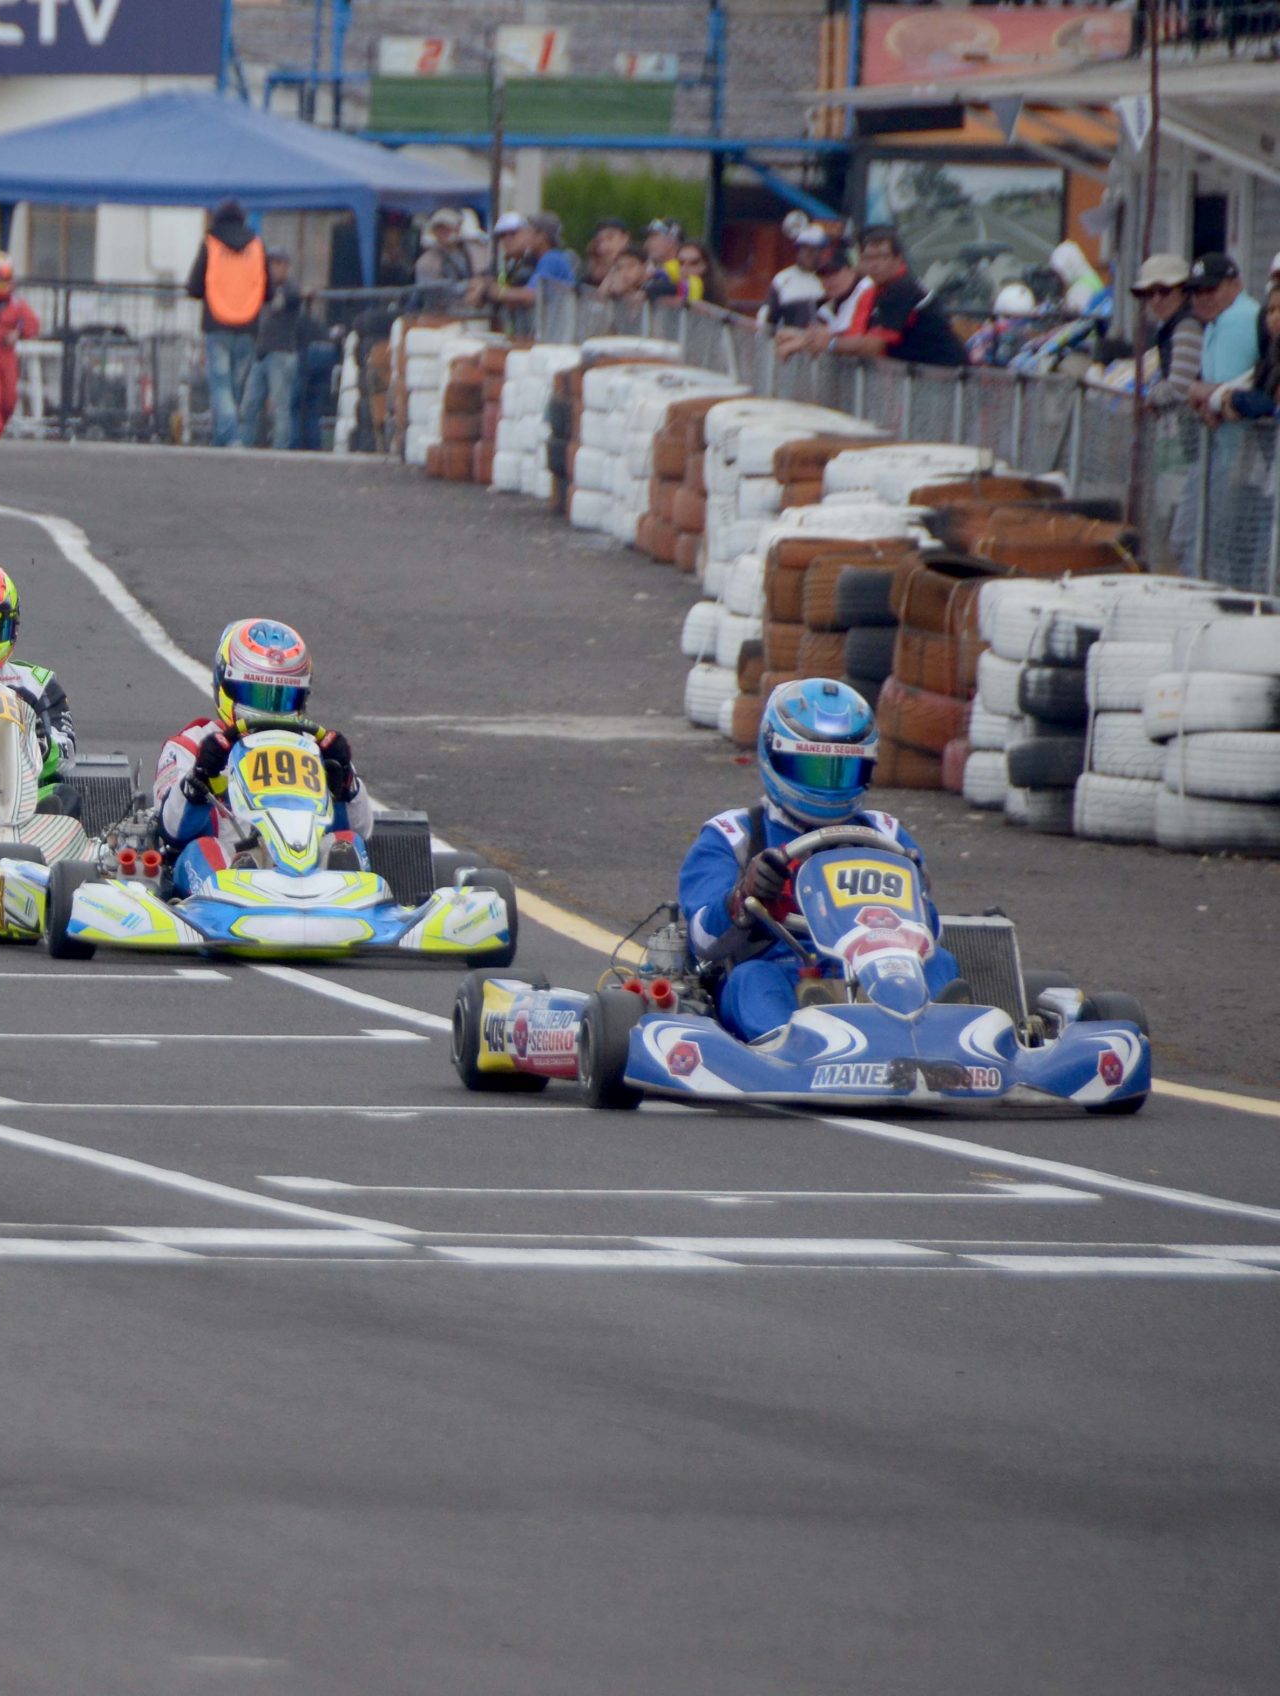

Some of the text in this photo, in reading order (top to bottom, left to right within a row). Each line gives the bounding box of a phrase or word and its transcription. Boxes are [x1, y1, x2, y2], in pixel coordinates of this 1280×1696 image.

[795, 742, 832, 753] MANEJO
[252, 749, 322, 793] 493
[836, 868, 904, 899] 409
[530, 1030, 575, 1052] SEGURO
